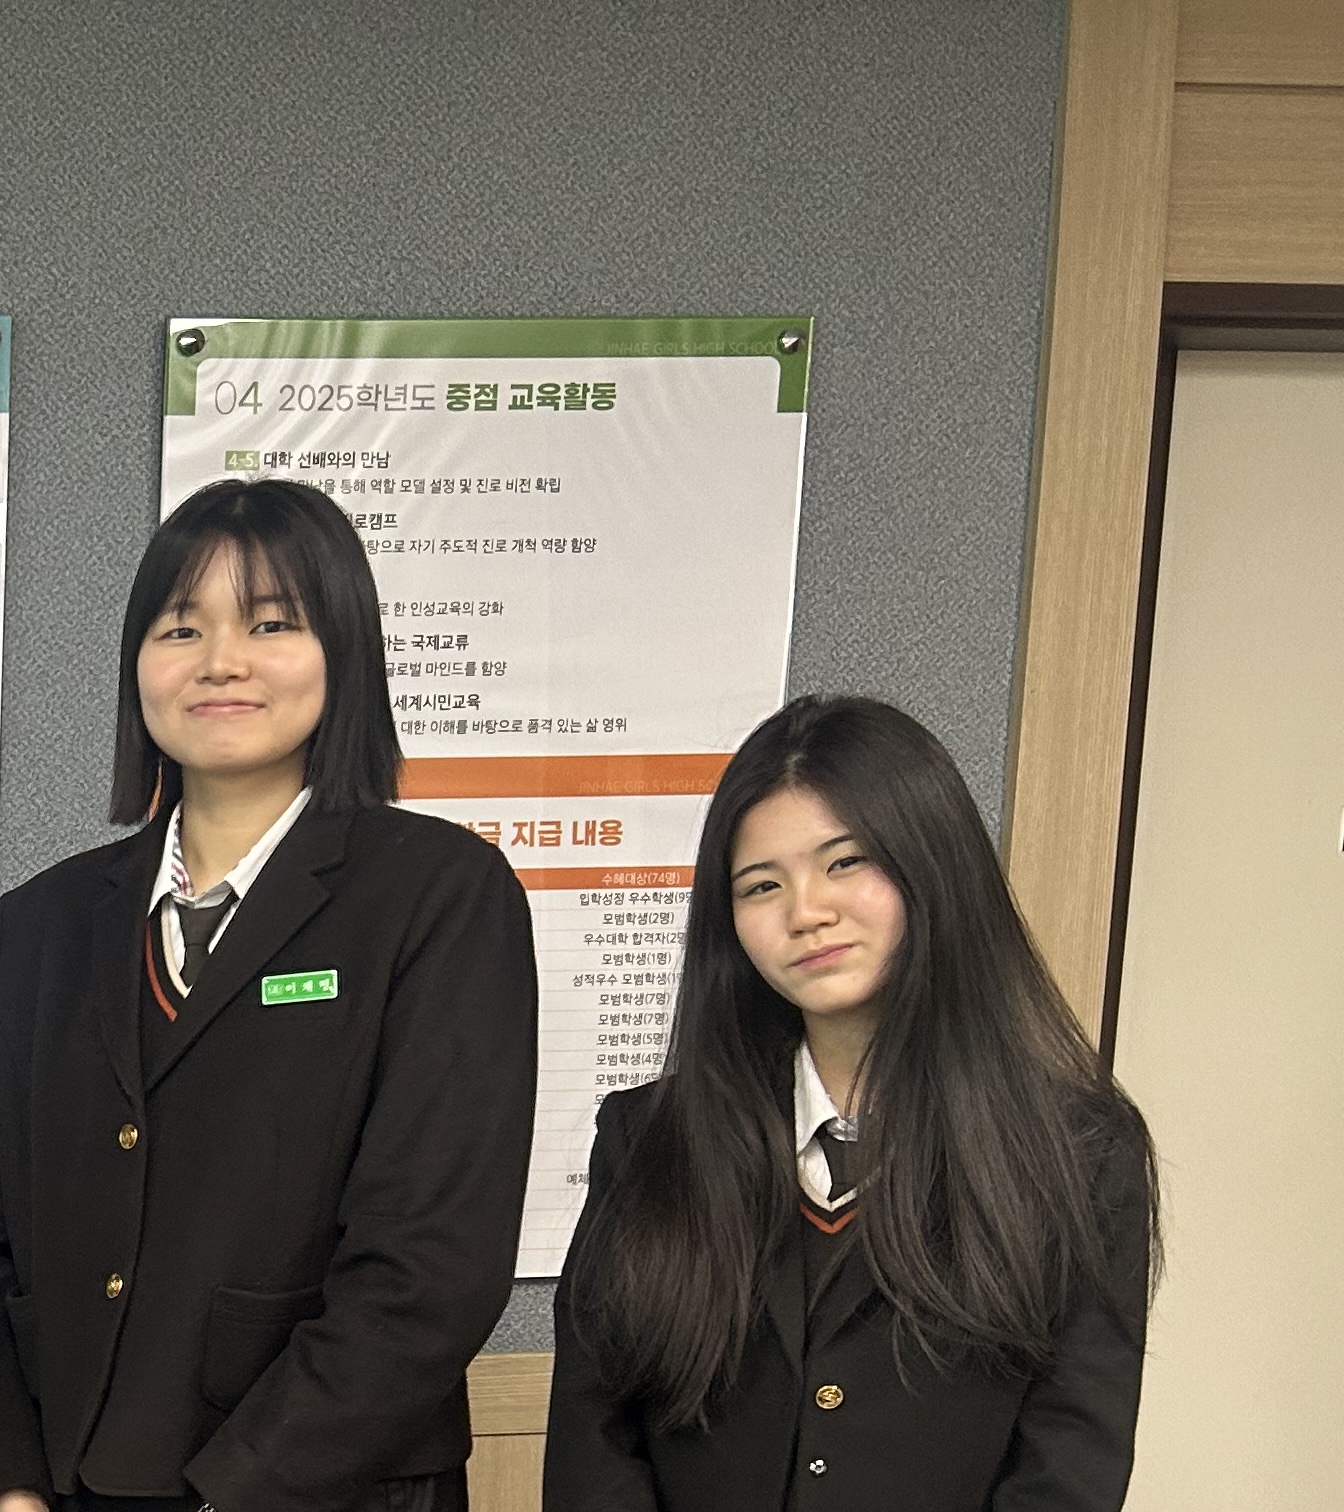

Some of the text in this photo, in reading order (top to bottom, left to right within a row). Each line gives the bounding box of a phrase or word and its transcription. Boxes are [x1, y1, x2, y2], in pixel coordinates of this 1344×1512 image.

[278, 382, 436, 412] 2025학년도
[446, 382, 500, 412] 중점
[508, 382, 617, 412] 교육활동
[228, 451, 391, 469] 4-5. 대학 선배와의 만남
[340, 479, 366, 495] 통해
[370, 478, 396, 494] 역할
[399, 478, 425, 494] 모델
[430, 478, 455, 494] 설정
[459, 478, 472, 494] 및
[476, 478, 501, 493] 진로
[505, 478, 531, 493] 비전
[535, 477, 561, 493] 확립
[408, 537, 597, 554] 자기 주도적 진로 개척 역량 함양
[410, 600, 504, 617] 인성교육의 강화
[410, 633, 469, 651] 국제교류
[425, 660, 507, 677] 마인드를 함양
[393, 693, 481, 711] 세계시민교육
[400, 717, 627, 735] 대한 이해를 바탕으로 품격 있는 삶 영위
[511, 818, 623, 847] 지급 내용
[602, 871, 681, 886] 수혜대상(74명)
[602, 911, 674, 926] 모범학생(2명)
[584, 932, 628, 946] 우수대학
[601, 952, 672, 966] 모범학생(1명)
[572, 973, 618, 987] 성적우수
[599, 992, 670, 1006] 모범학생(7명)
[598, 1012, 669, 1026] 모범학생(7명)
